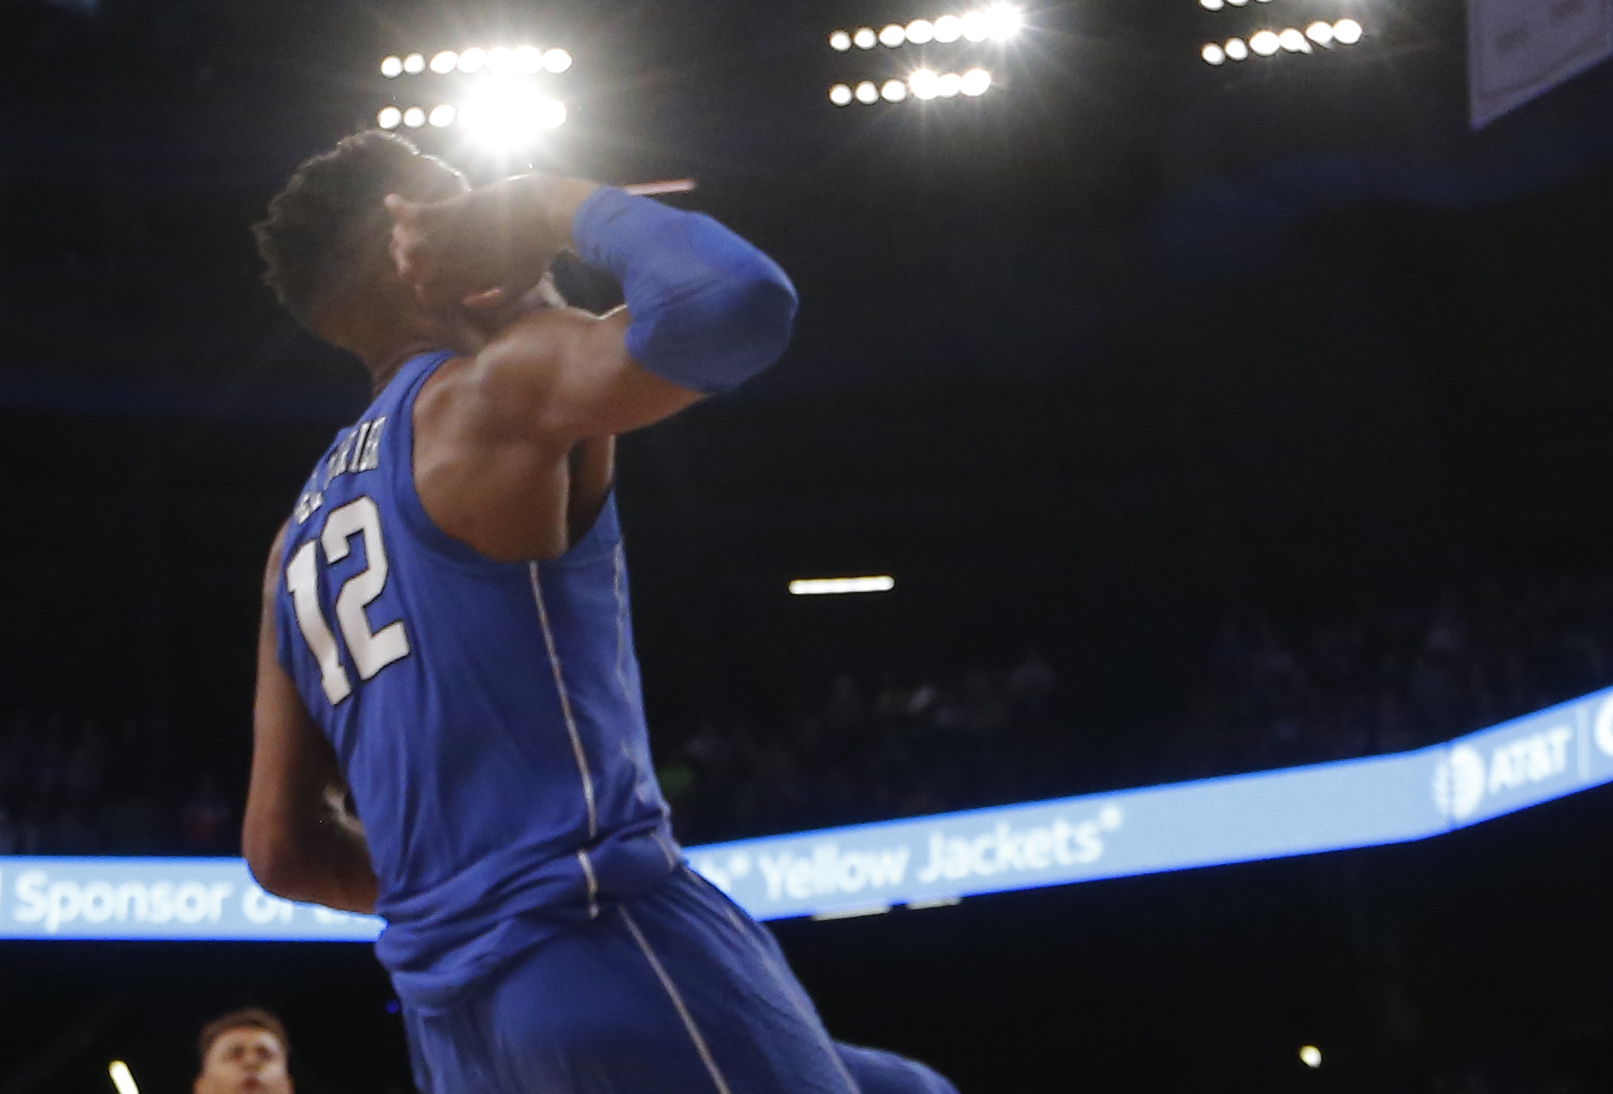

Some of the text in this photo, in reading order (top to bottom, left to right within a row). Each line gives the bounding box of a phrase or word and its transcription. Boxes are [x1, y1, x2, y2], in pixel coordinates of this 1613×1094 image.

[286, 494, 410, 706] 12
[1489, 726, 1573, 795] AT&T
[13, 868, 235, 934] Sponsor
[757, 842, 912, 902] Yellow
